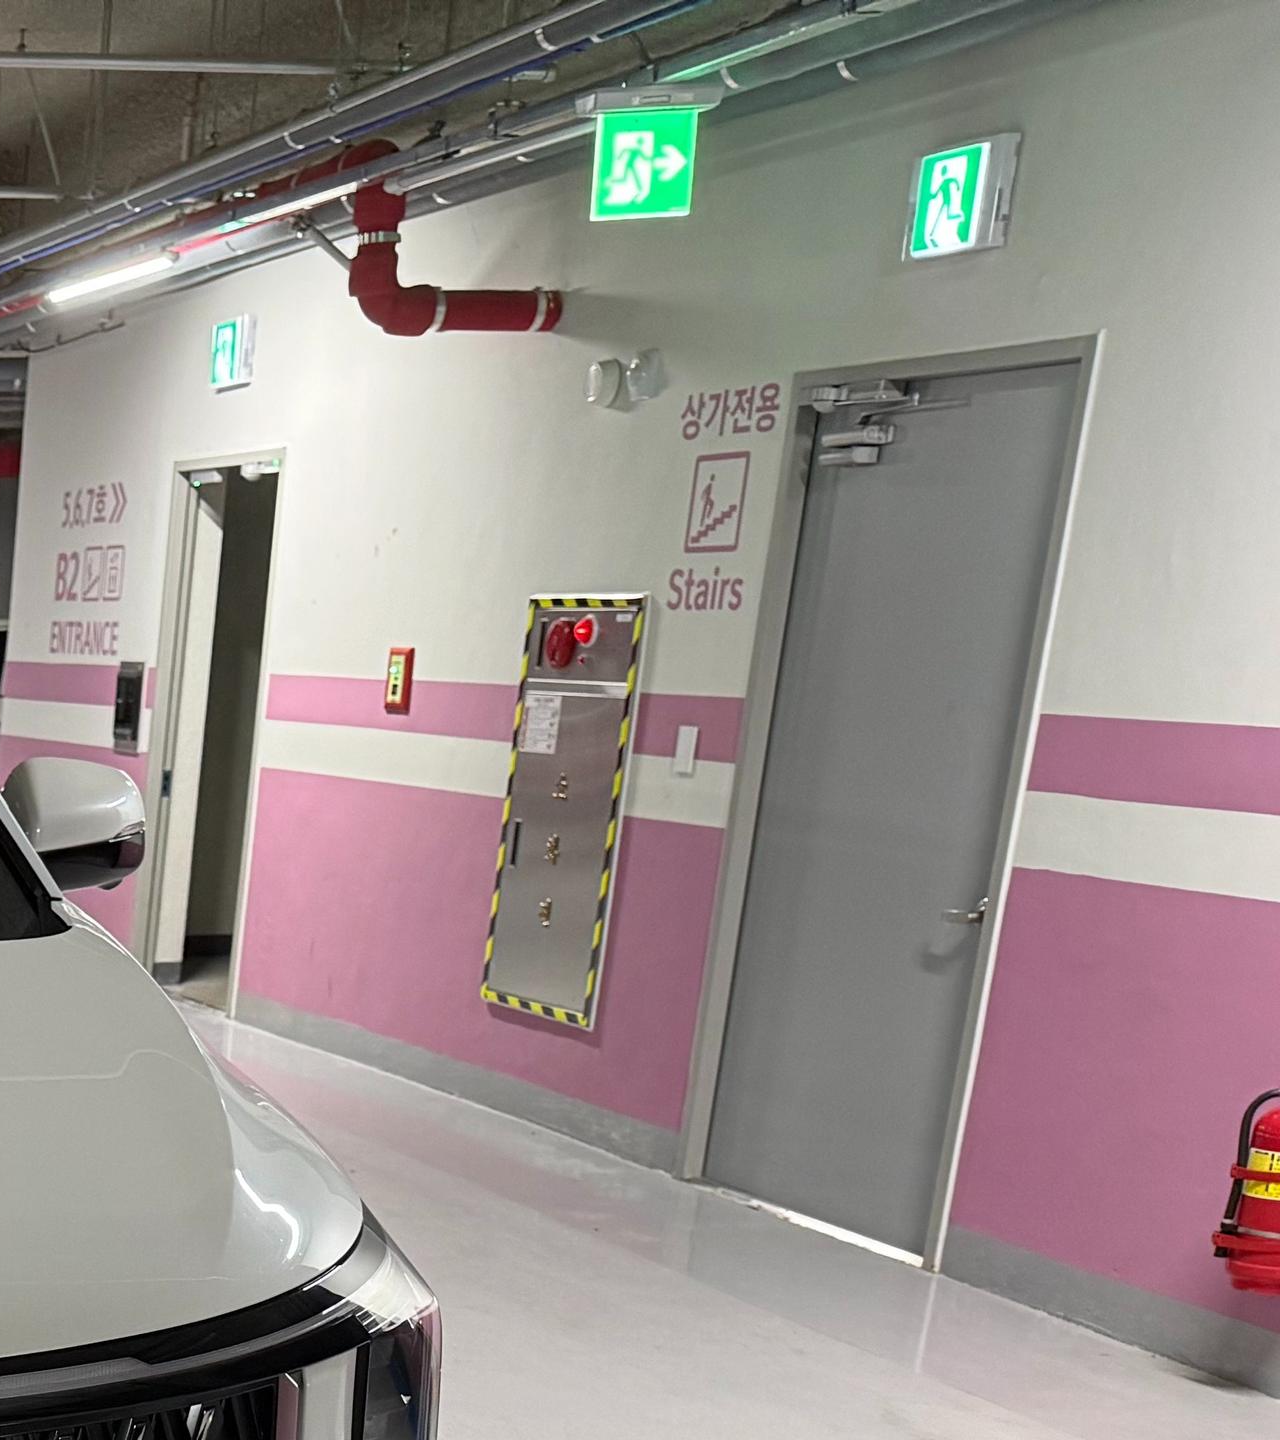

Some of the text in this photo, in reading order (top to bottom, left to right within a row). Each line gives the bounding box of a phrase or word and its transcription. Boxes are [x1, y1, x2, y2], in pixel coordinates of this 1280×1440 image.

[680, 383, 780, 440] 상가전용
[54, 552, 80, 601] B2
[667, 566, 744, 611] Stairs
[49, 621, 119, 656] ENTRANCE
